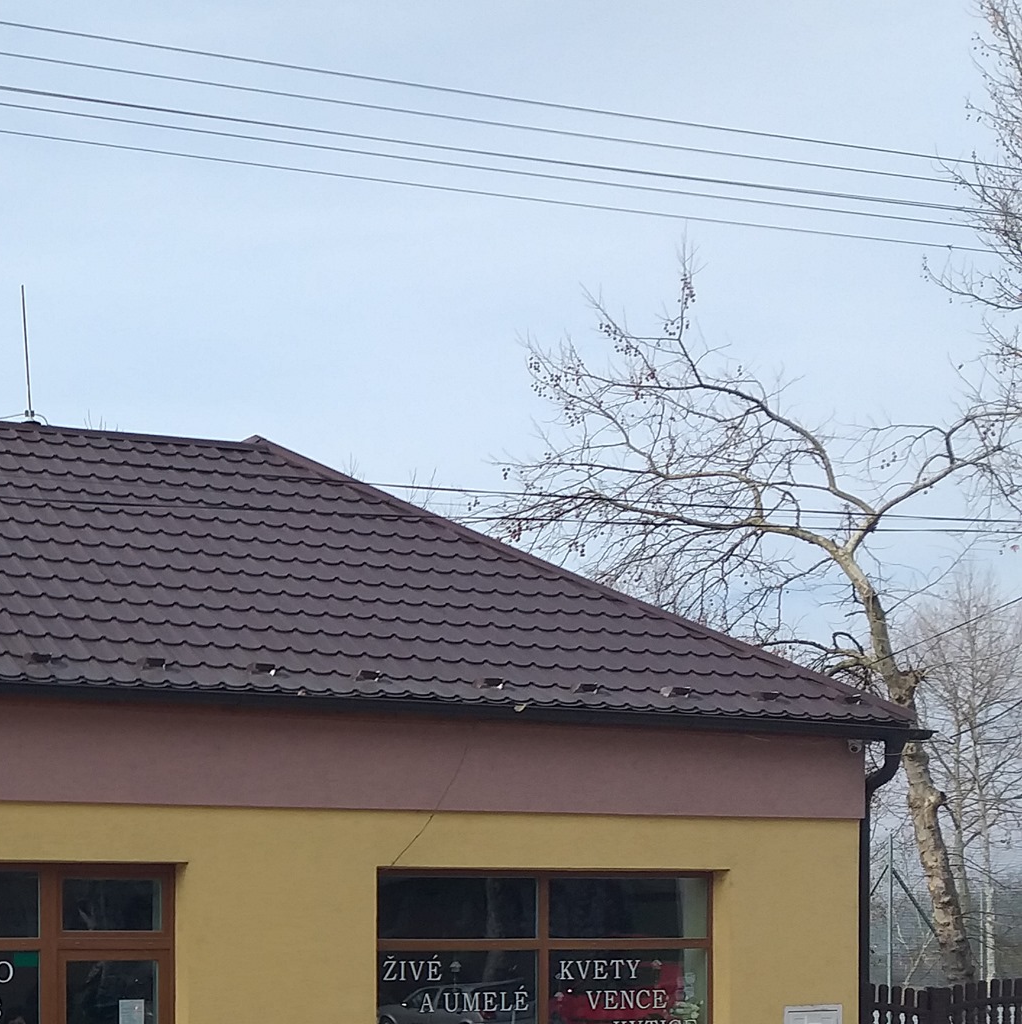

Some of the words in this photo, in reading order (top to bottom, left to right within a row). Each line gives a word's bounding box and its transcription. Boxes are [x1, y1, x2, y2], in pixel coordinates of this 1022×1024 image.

[382, 954, 443, 982] ŽIVÉ
[558, 959, 641, 980] KVETY
[419, 993, 435, 1013] A
[443, 985, 529, 1013] UMELÉ
[585, 989, 668, 1010] VENCE
